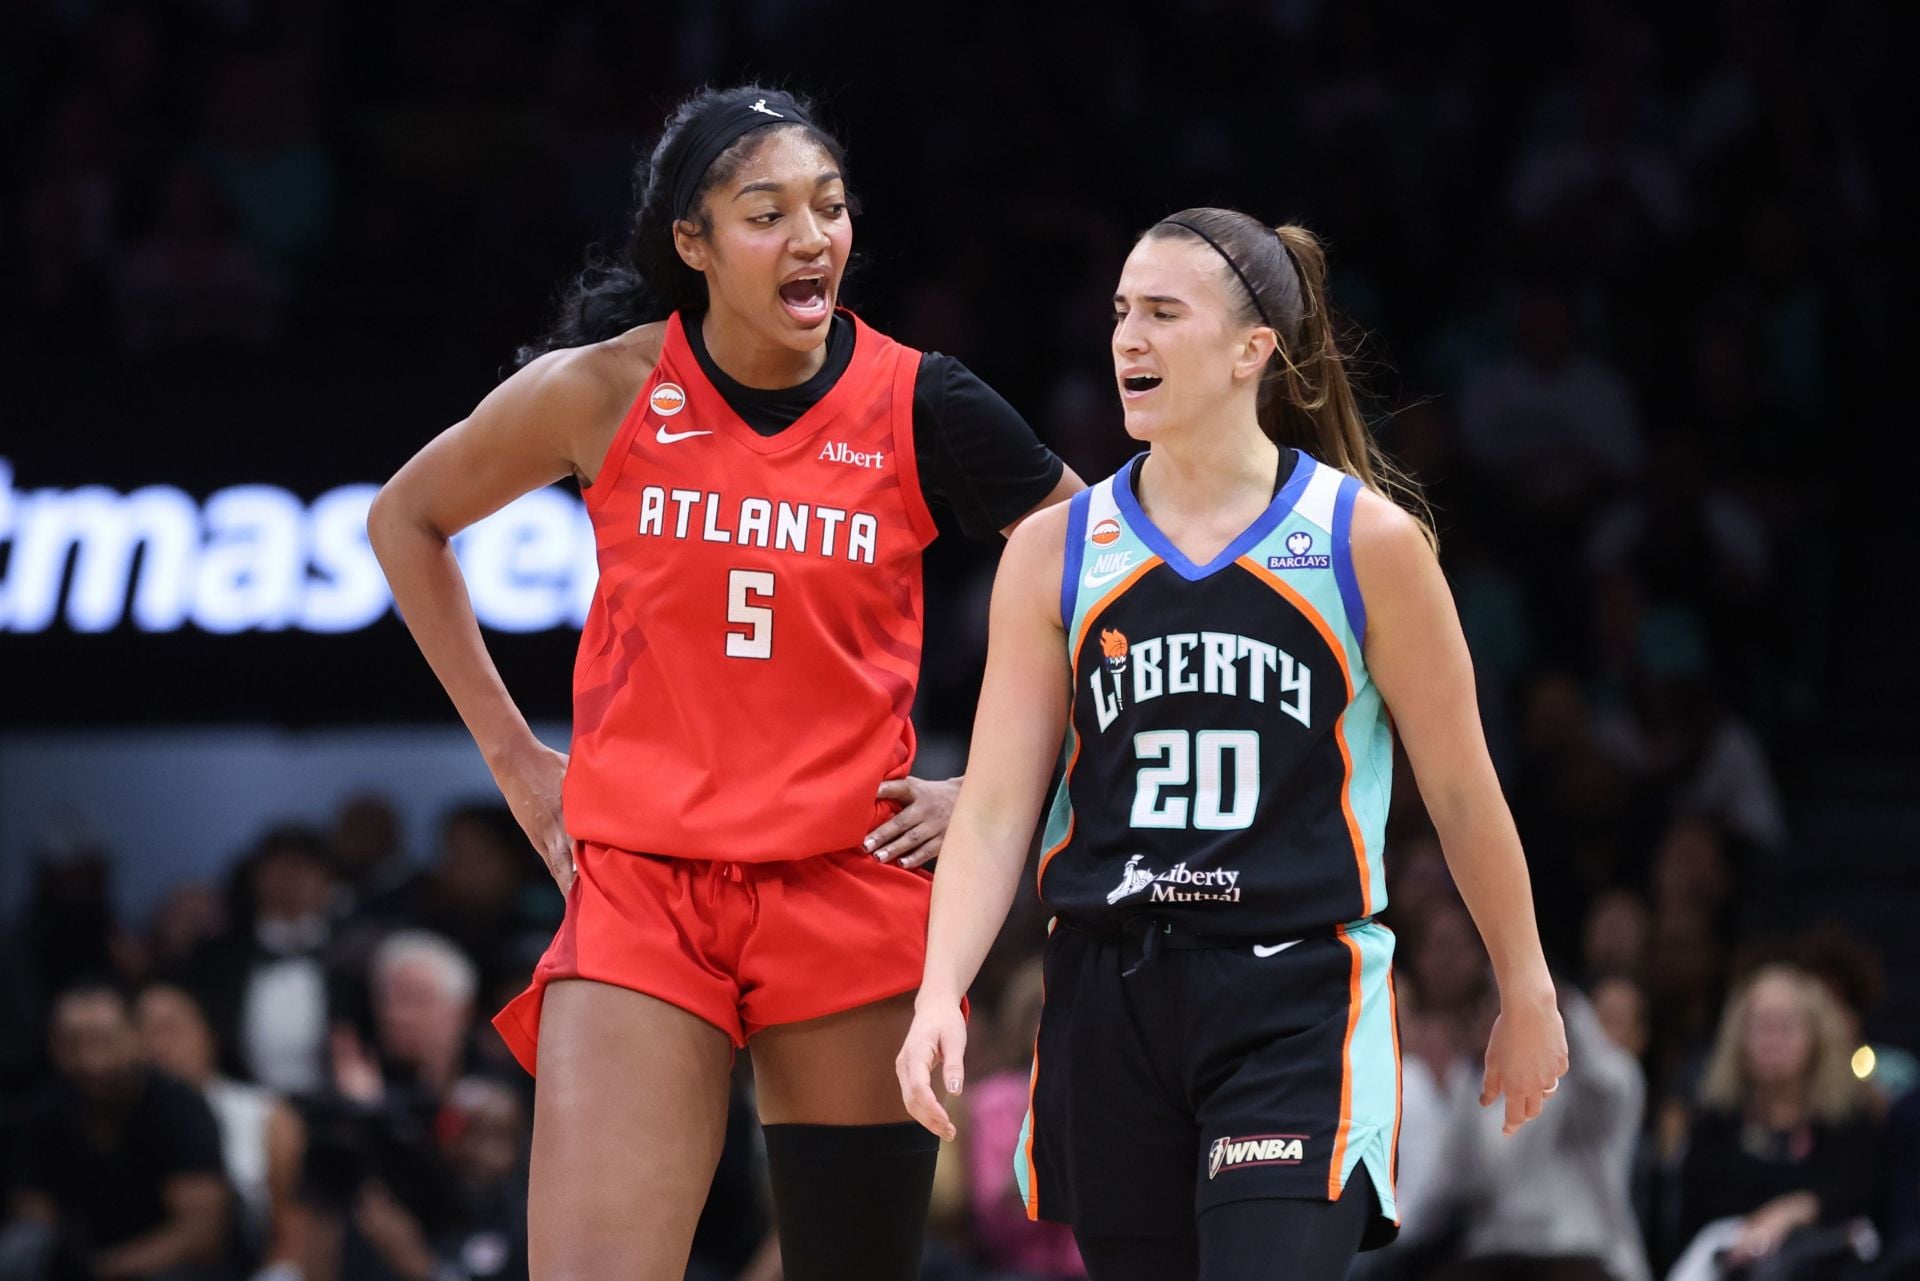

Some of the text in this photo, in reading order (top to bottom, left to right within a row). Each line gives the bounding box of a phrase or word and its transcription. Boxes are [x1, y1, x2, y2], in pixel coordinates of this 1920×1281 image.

[818, 440, 884, 469] Albert
[638, 485, 879, 565] ATLANTA
[1093, 551, 1133, 575] NIKE
[1269, 556, 1329, 568] BARCLAYS
[724, 568, 776, 660] 5
[1089, 628, 1312, 734] LIBERTY
[1129, 729, 1261, 831] 20
[1149, 883, 1241, 903] Mutual
[1154, 861, 1240, 894] Liberty
[1225, 1139, 1304, 1165] WNBA
